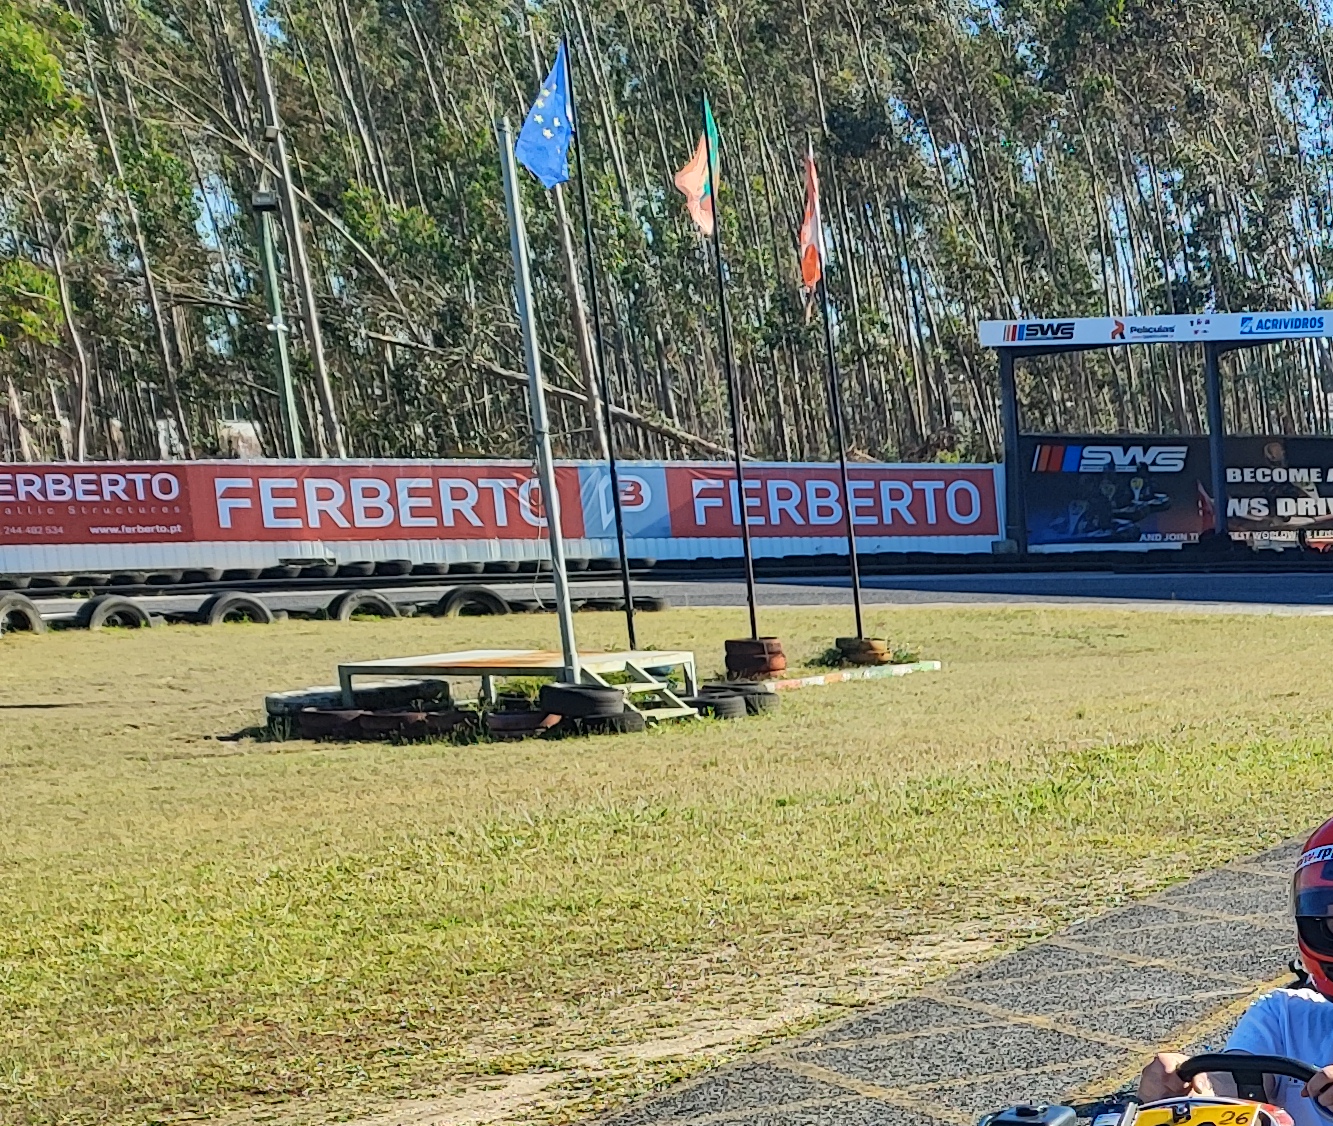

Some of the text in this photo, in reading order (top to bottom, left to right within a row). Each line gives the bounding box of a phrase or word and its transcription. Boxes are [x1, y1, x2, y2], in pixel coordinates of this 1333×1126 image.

[1025, 322, 1076, 341] SWS
[1255, 316, 1324, 332] ACRIVIDROS
[1079, 445, 1188, 473] SWS
[1225, 467, 1323, 483] BECOME
[0, 472, 180, 502] ERBERTO
[67, 504, 181, 516] Structures
[691, 479, 982, 527] FERBERTO
[88, 524, 183, 535] www.ferberto.pt
[1139, 532, 1162, 542] AND
[1164, 531, 1188, 542] JOIN
[1218, 1110, 1251, 1126] 26
